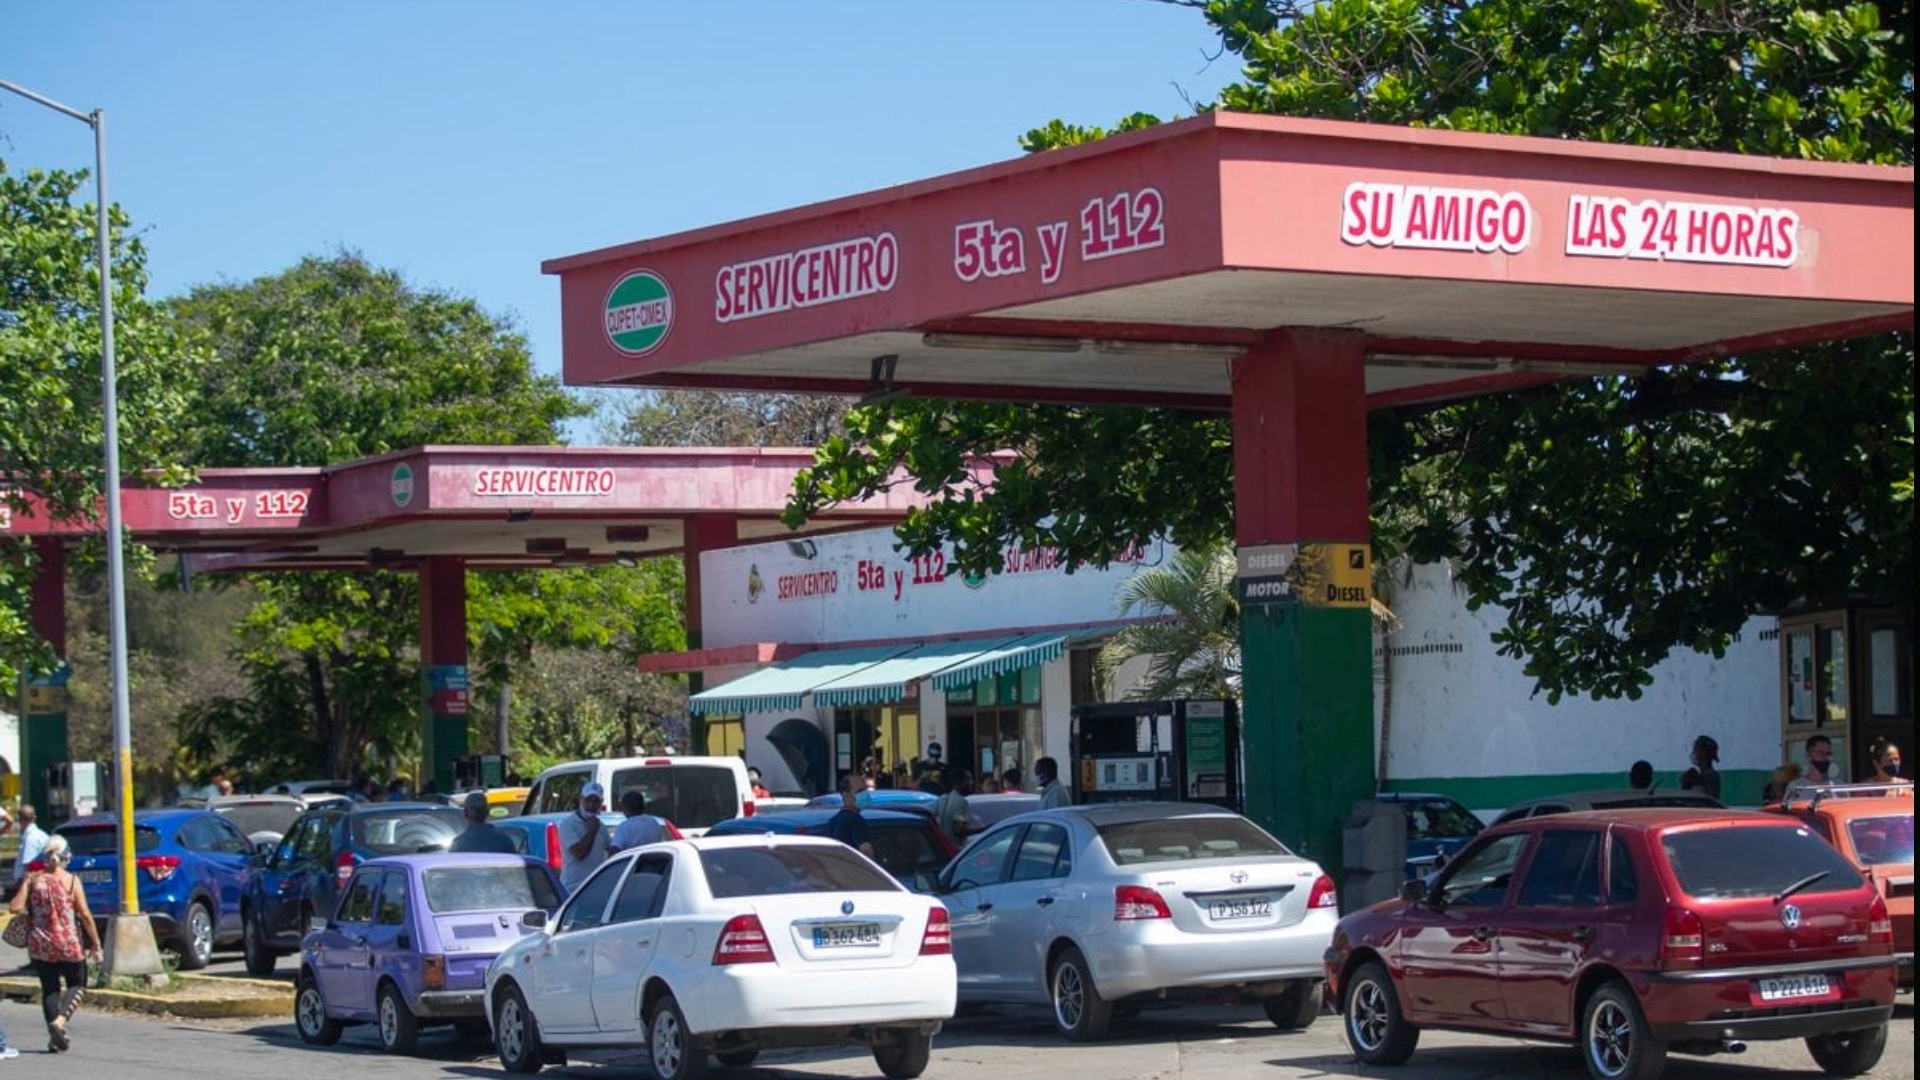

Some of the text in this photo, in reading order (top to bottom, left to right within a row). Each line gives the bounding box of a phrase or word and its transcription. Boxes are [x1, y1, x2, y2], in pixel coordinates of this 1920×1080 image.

[956, 190, 1163, 283] 5ta y 112
[1347, 189, 1527, 246] SU AMIGO
[1571, 201, 1795, 259] LAS 24 HORAS
[716, 234, 898, 321] SERVICENTRO
[476, 470, 614, 493] SERVICENTRO
[170, 494, 307, 521] 5ta y 112
[857, 550, 945, 601] 5ta y 112
[1247, 553, 1287, 569] DIESEL
[778, 570, 839, 600] SERVICENTRO
[1246, 581, 1290, 598] MOTOR
